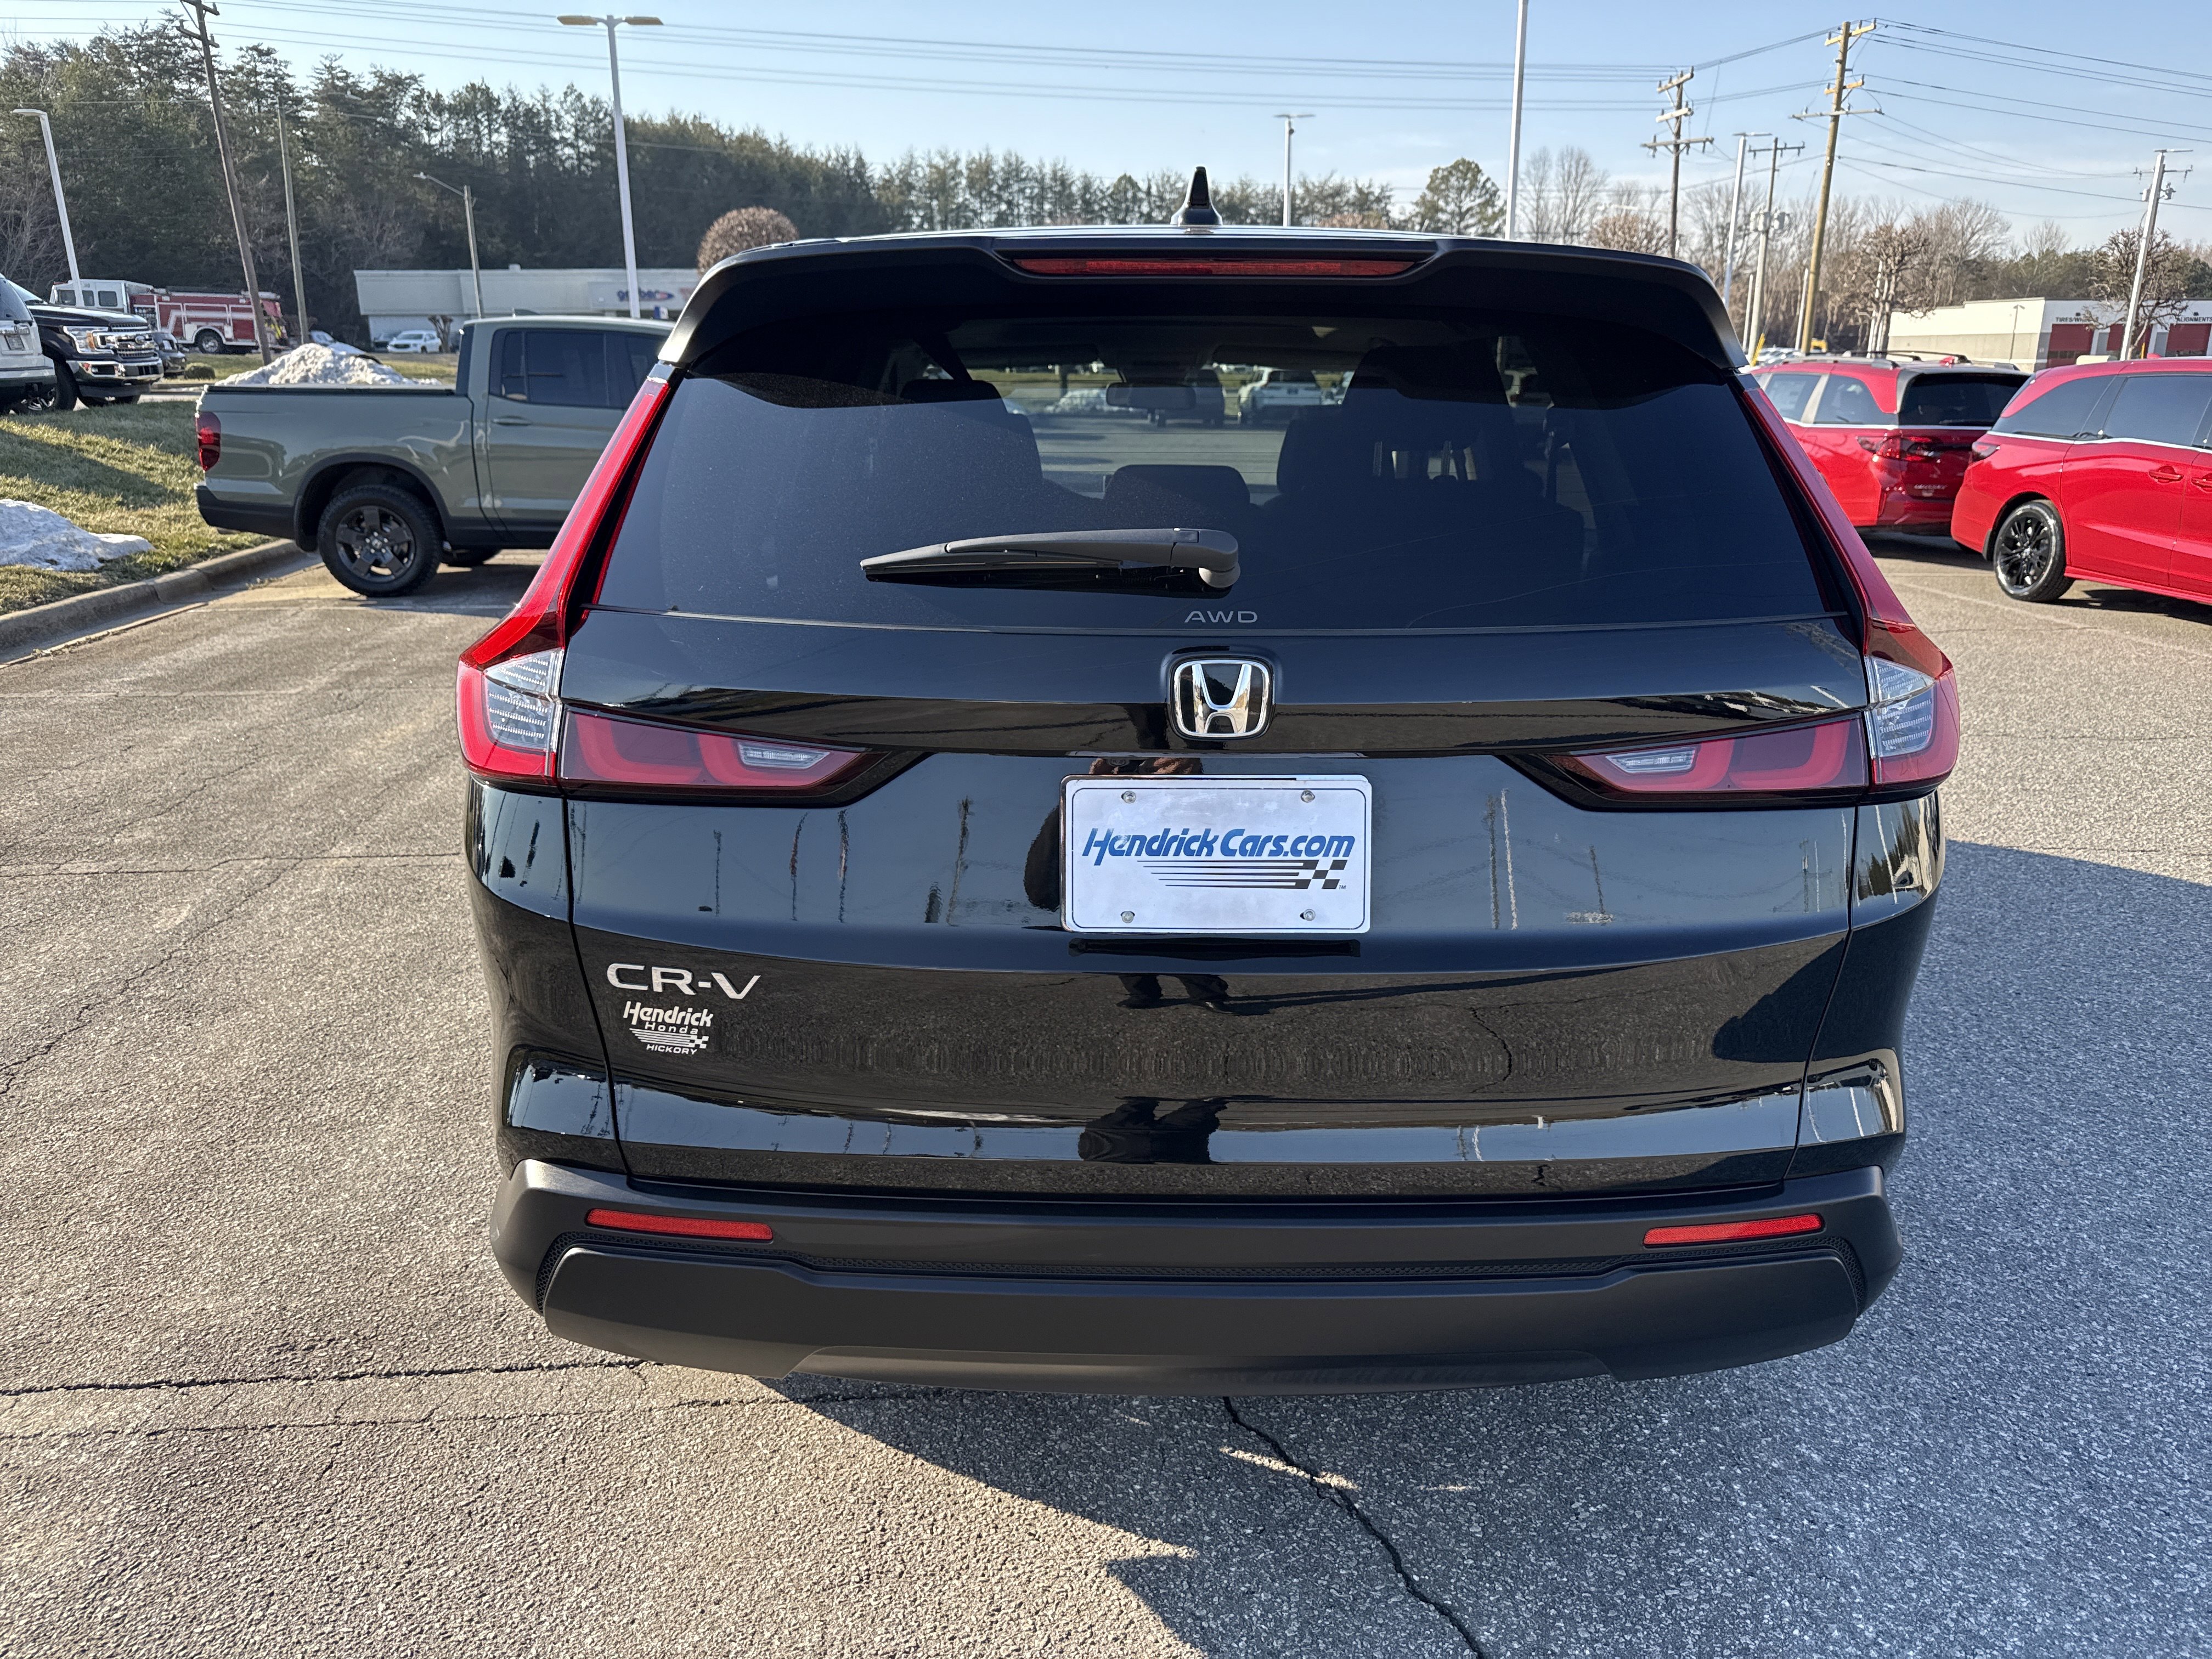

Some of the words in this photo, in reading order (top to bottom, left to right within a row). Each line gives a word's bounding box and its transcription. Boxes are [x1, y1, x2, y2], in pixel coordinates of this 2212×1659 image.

[1184, 611, 1258, 623] AWD
[1082, 828, 1356, 866] HendrickCars.com
[607, 963, 761, 1000] CR-V
[623, 1001, 714, 1027] Hendrick
[644, 1021, 698, 1035] Honda
[646, 1043, 698, 1055] HICKORY
